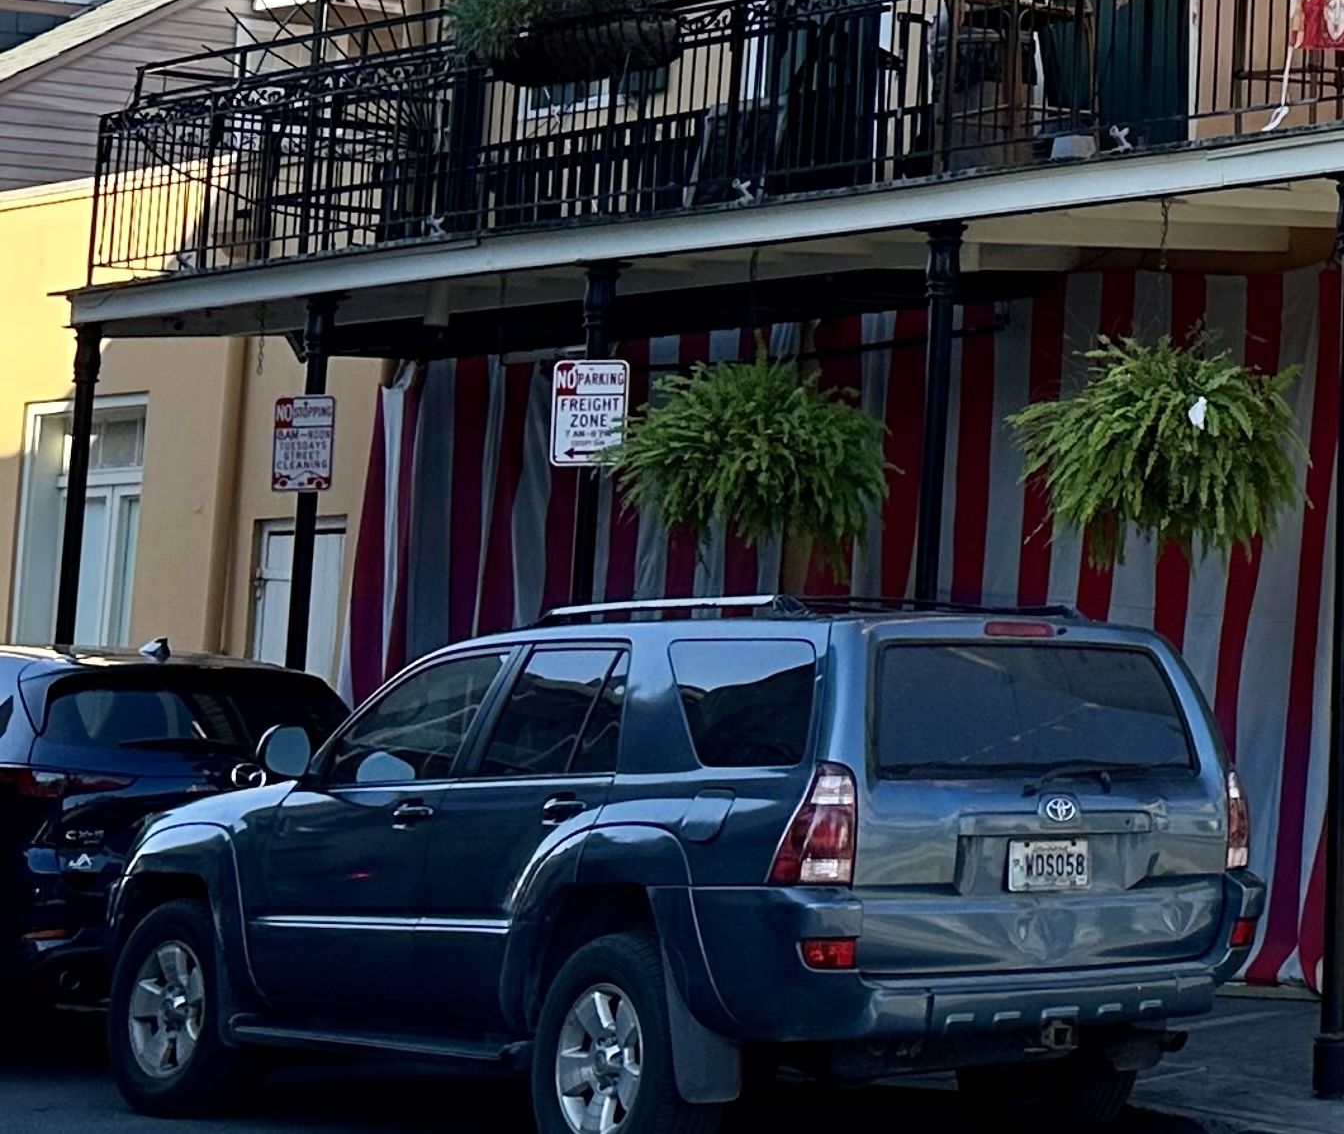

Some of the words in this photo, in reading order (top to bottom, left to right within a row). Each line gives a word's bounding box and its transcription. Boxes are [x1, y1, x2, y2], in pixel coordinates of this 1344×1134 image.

[556, 370, 577, 389] NO
[577, 373, 625, 386] PARKING
[561, 397, 620, 412] FREIGHT
[276, 404, 292, 422] NO
[570, 413, 608, 428] ZONE
[284, 451, 320, 460] STREET
[277, 460, 328, 470] CLEANING
[1025, 853, 1085, 877] WDS058
